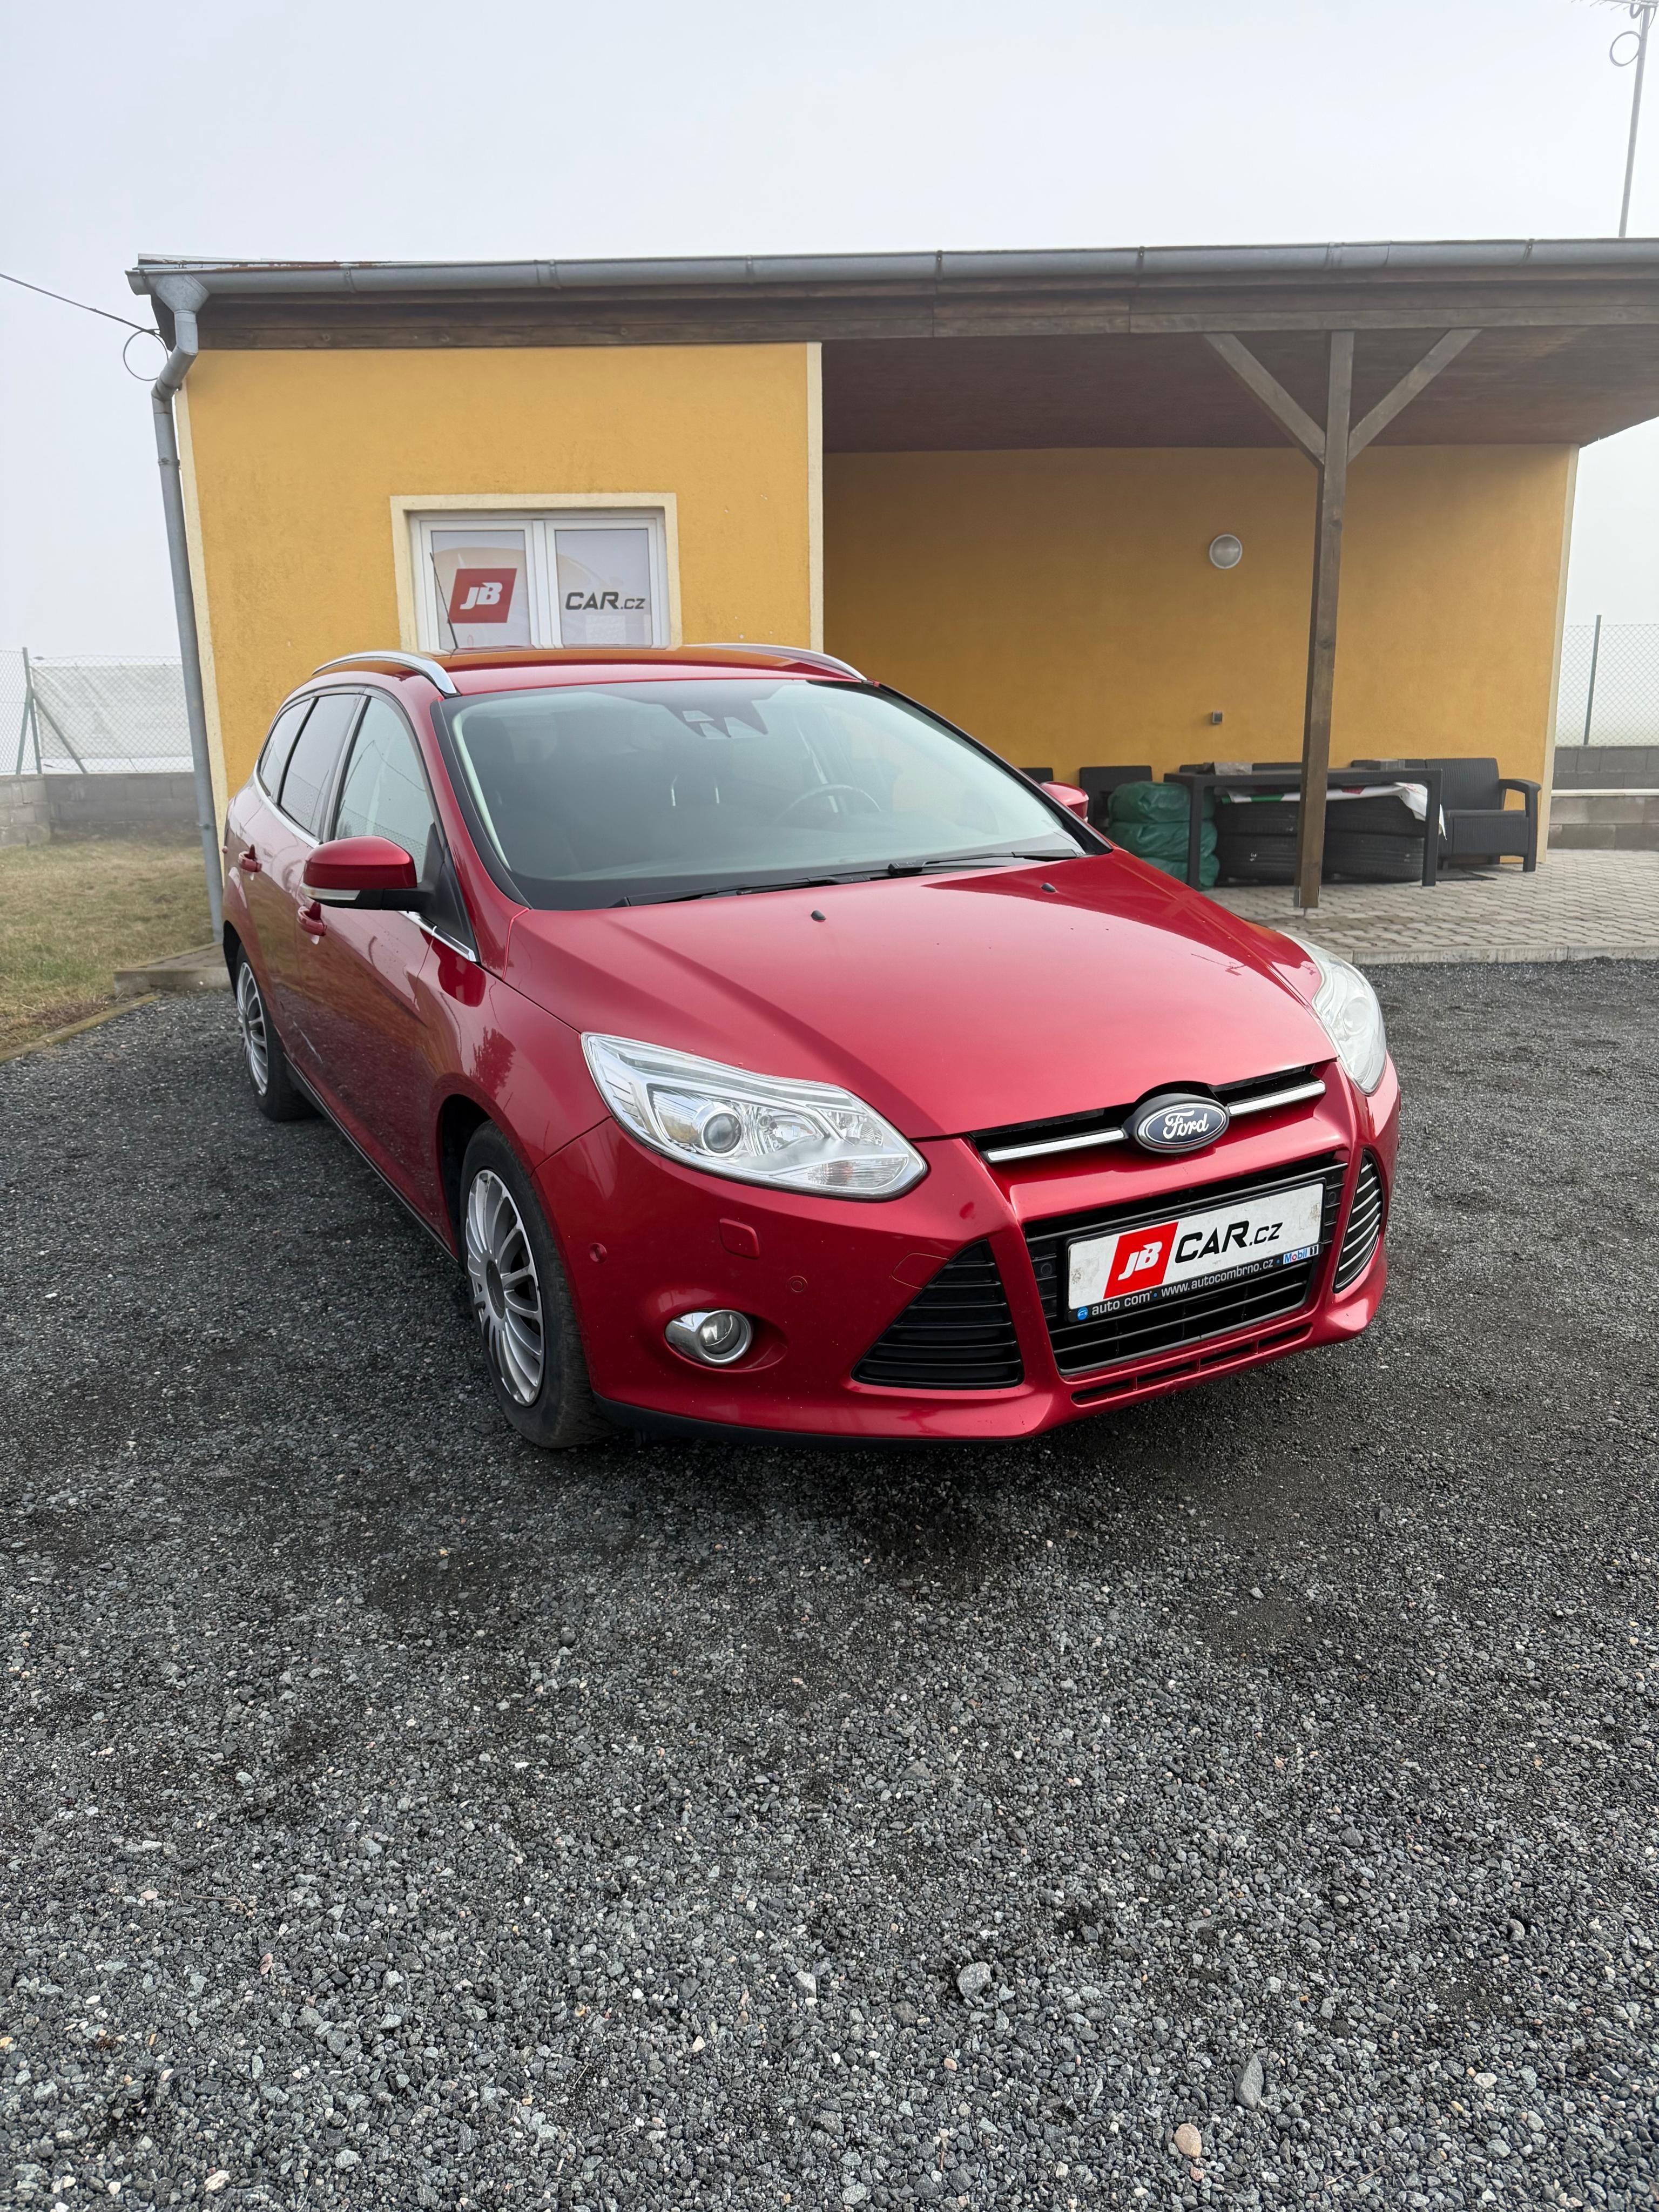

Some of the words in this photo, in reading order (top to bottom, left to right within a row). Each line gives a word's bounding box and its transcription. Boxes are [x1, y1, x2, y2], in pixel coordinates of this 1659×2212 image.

[460, 582, 503, 610] JB
[1163, 1110, 1209, 1139] Ford
[1117, 1240, 1163, 1281] JB
[1091, 1300, 1120, 1316] auto
[1161, 1258, 1273, 1298] www.autocombrno.cz
[1285, 1249, 1307, 1263] Mobil
